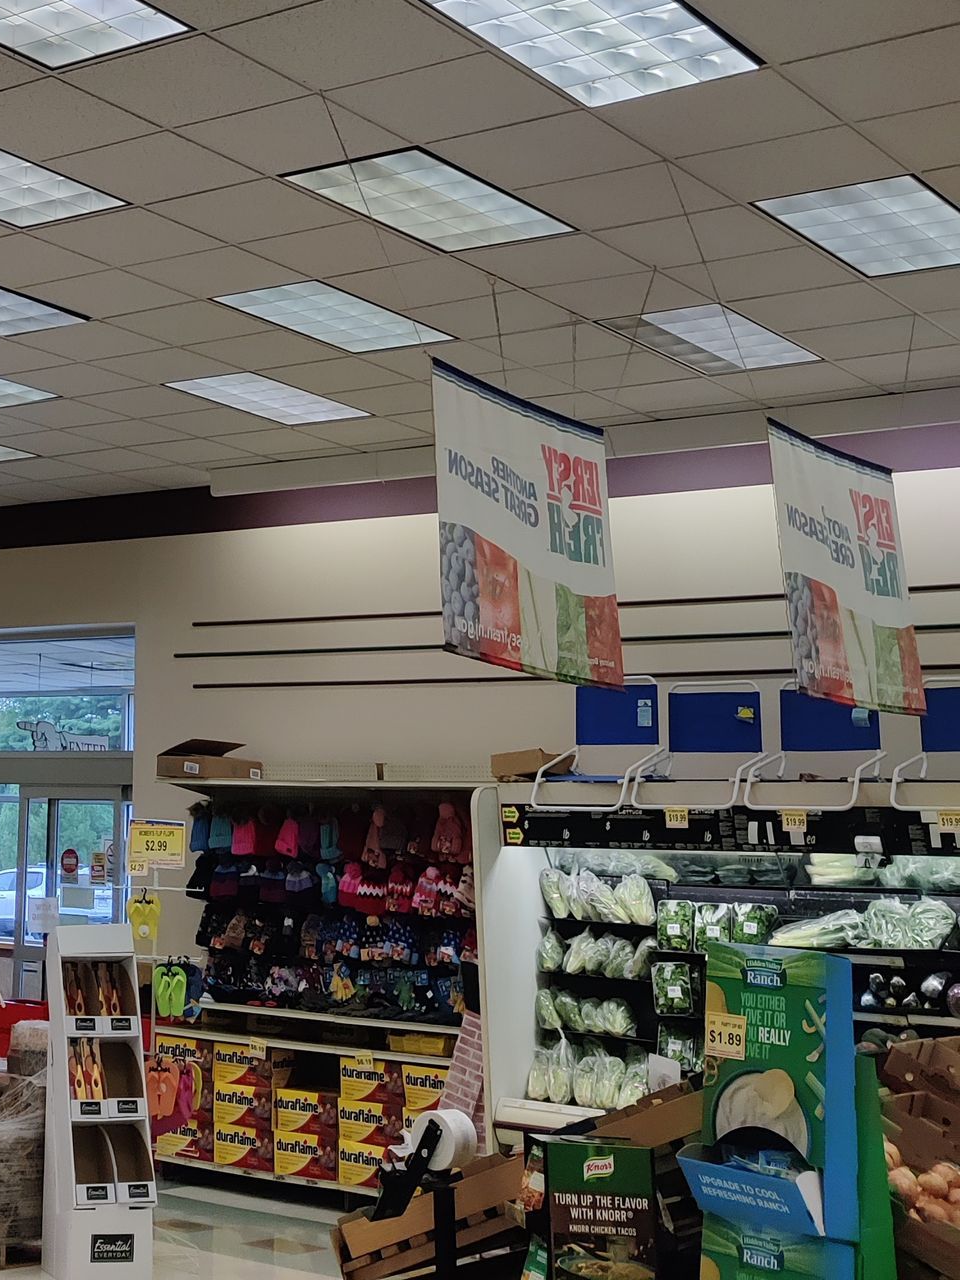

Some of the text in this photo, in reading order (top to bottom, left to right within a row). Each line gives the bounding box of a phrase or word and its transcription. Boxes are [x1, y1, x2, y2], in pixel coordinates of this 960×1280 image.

[786, 817, 805, 827] $19.99
[642, 830, 651, 841] lb
[145, 840, 168, 852] $2.99
[747, 960, 782, 971] Hidden Valley
[747, 971, 782, 987] Ranch
[741, 992, 786, 1011] YOU EITHER
[763, 1009, 772, 1027] IT
[774, 1012, 786, 1028] OR
[709, 1029, 742, 1047] $1.89
[746, 1027, 791, 1046] OU REALLY
[158, 1042, 197, 1058] duraflame
[215, 1049, 254, 1066] duraflame
[761, 1045, 771, 1060] IT
[405, 1072, 445, 1090] duraflam
[215, 1090, 254, 1107] duraflame
[278, 1096, 319, 1113] duraflame
[340, 1109, 383, 1126] duraflame
[216, 1129, 257, 1147] duraflame
[276, 1138, 319, 1156] duraflame
[340, 1149, 383, 1167] duraflame
[585, 1162, 612, 1174] Knorr
[698, 1174, 784, 1202] UPGRADE TO COOL,
[554, 1192, 649, 1210] TURN UP THE FLAVOR
[701, 1186, 790, 1214] REFRESHING RANCH
[570, 1207, 594, 1220] WITH
[569, 1224, 637, 1237] KNORR CHICKEN TACOS
[94, 1239, 132, 1252] Essential
[743, 1235, 763, 1247] Hidden
[743, 1249, 778, 1270] Ranch
